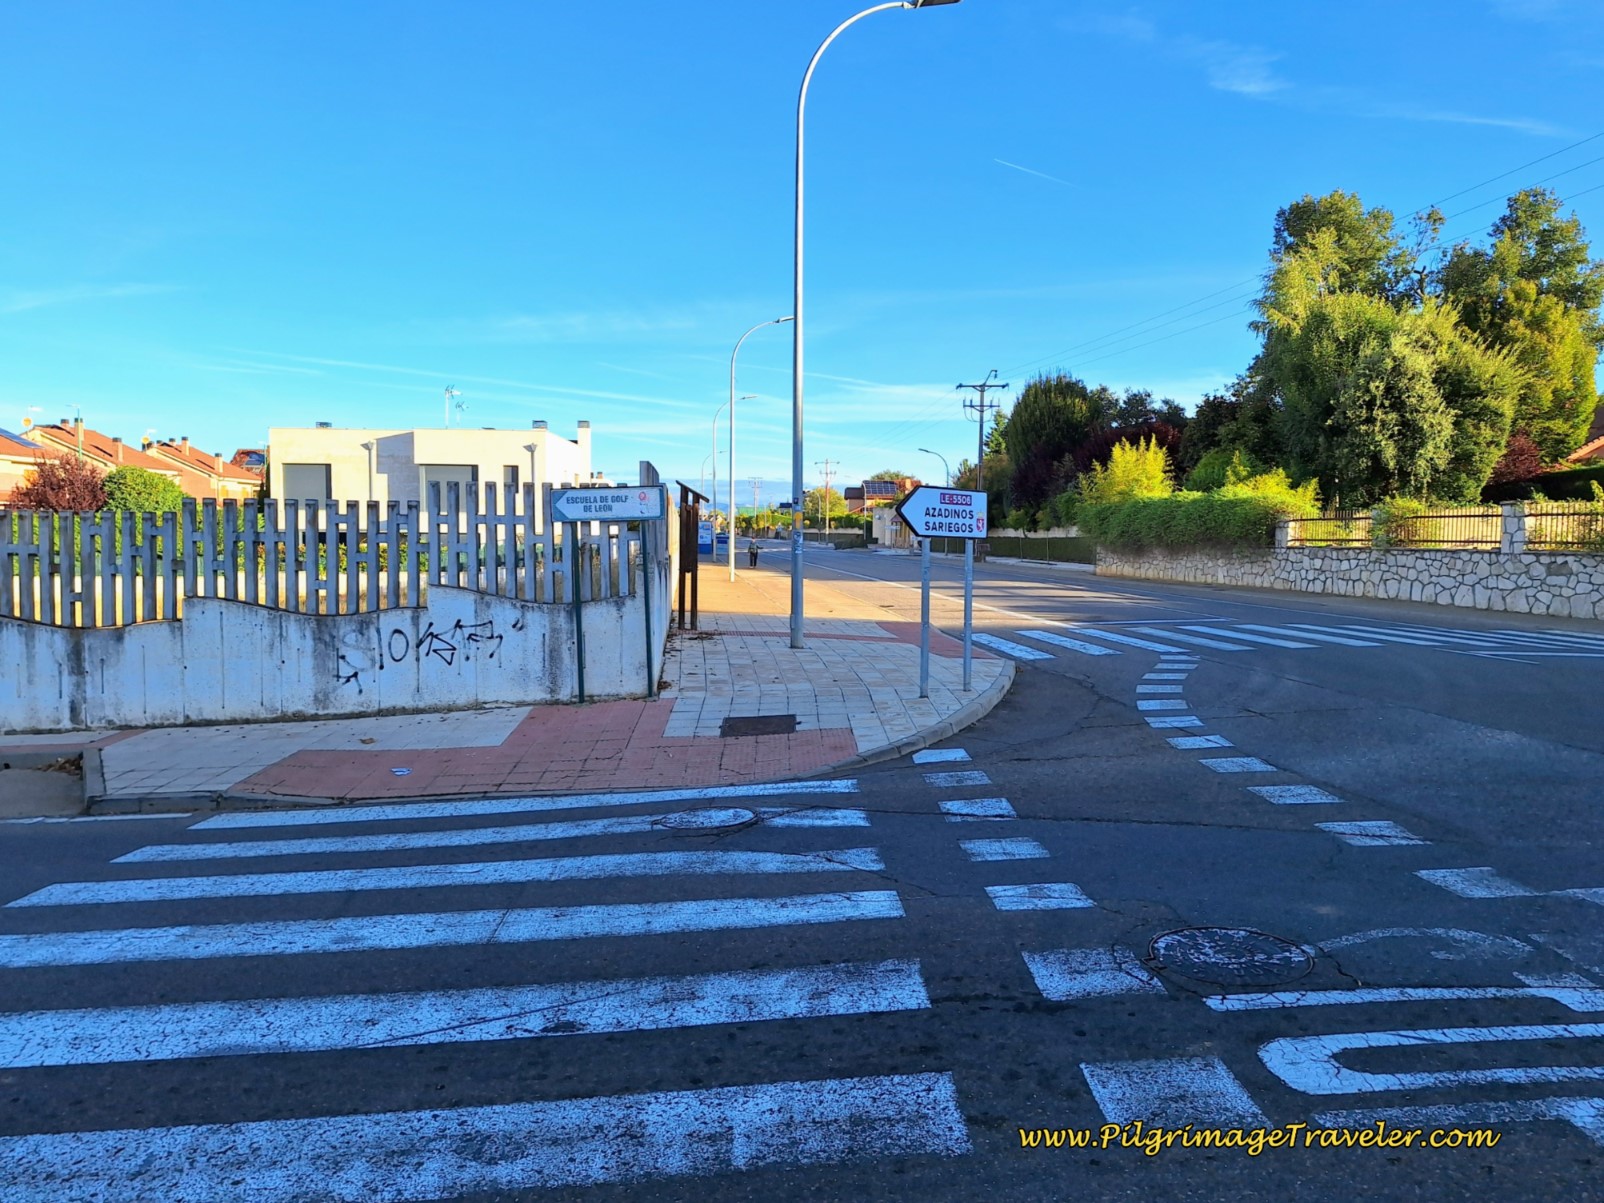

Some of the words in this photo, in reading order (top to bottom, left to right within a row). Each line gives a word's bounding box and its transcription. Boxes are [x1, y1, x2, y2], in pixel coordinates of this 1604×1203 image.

[566, 495, 598, 505] ESCUELA
[599, 495, 609, 503] DE
[610, 495, 629, 503] GOLF
[941, 494, 972, 505] LE-5506
[583, 504, 593, 513] DE
[924, 507, 974, 520] AZADINOS
[924, 521, 974, 533] SARIEGOS
